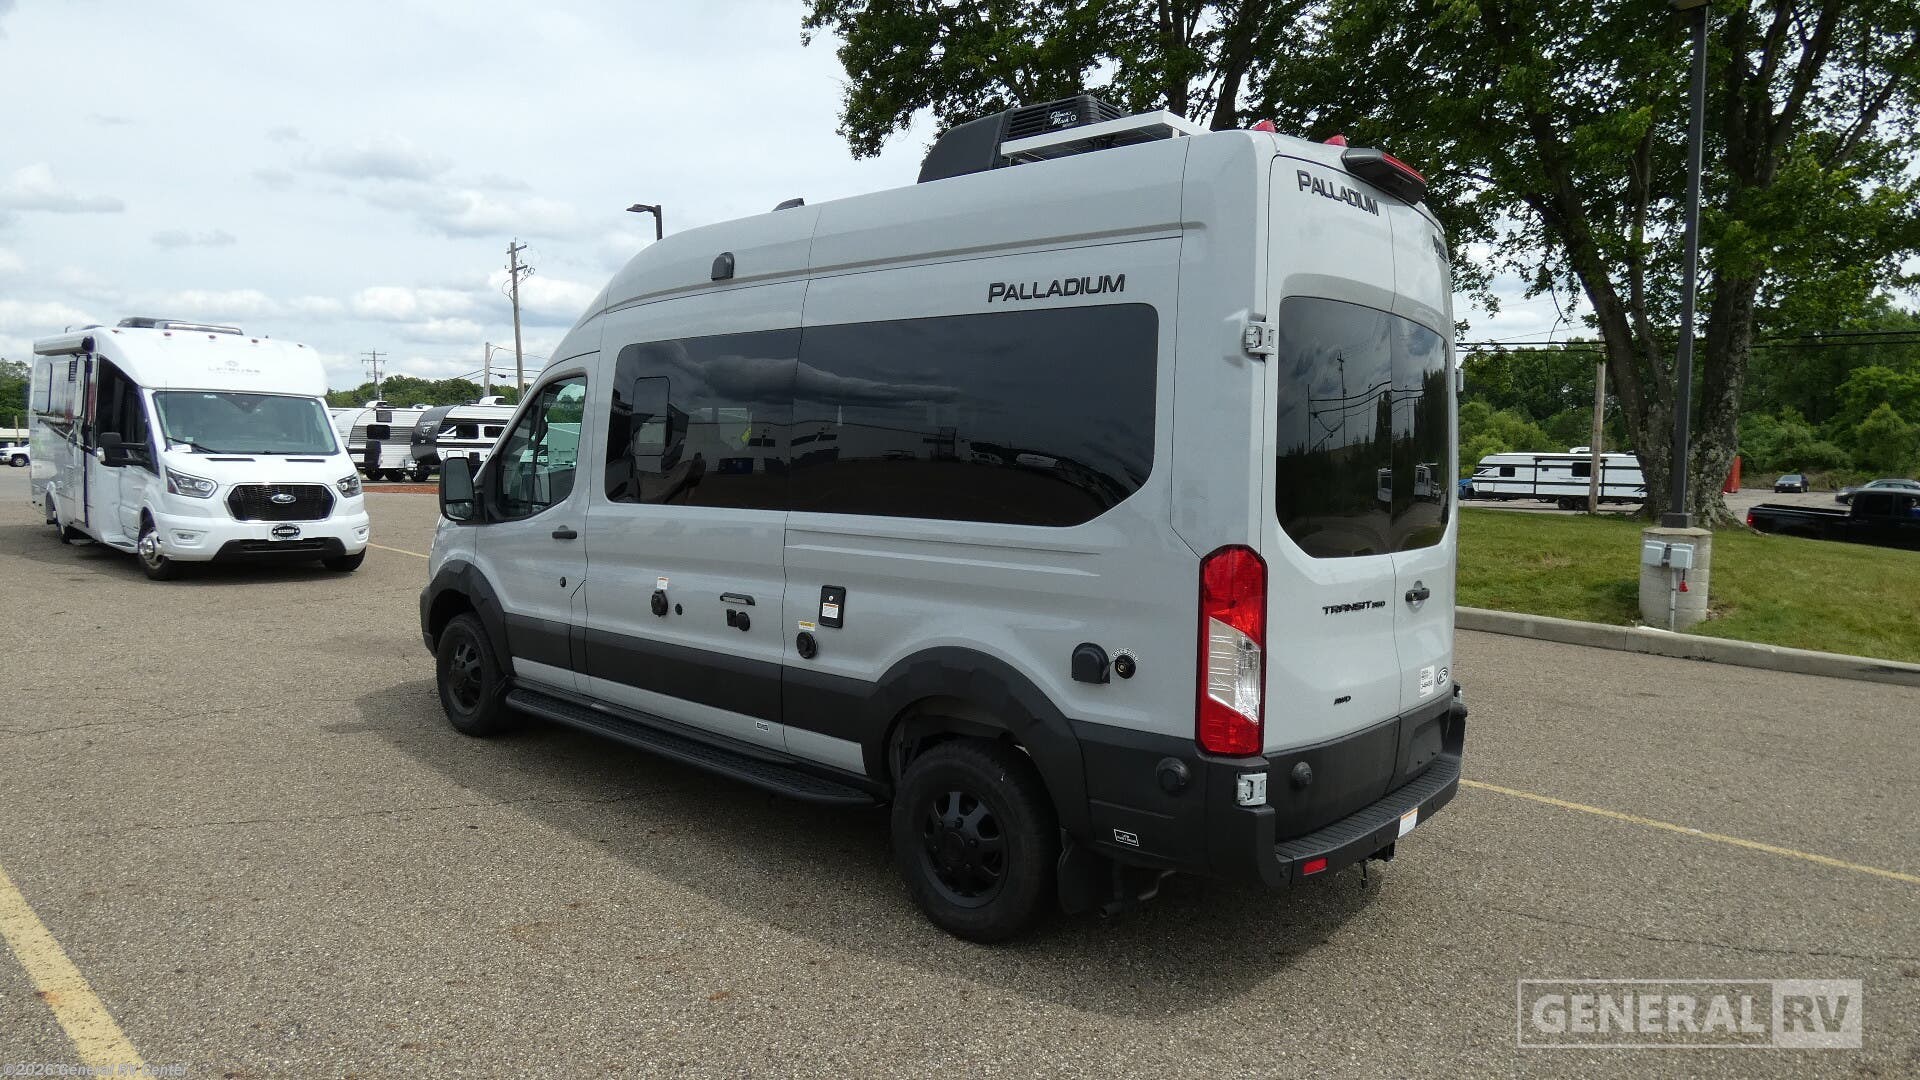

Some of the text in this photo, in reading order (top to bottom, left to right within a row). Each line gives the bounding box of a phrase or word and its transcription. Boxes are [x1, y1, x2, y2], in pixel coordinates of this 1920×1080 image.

[1297, 169, 1379, 216] PALLADIUM
[988, 274, 1125, 302] PALLADIUM
[1322, 600, 1372, 615] TRANSIT
